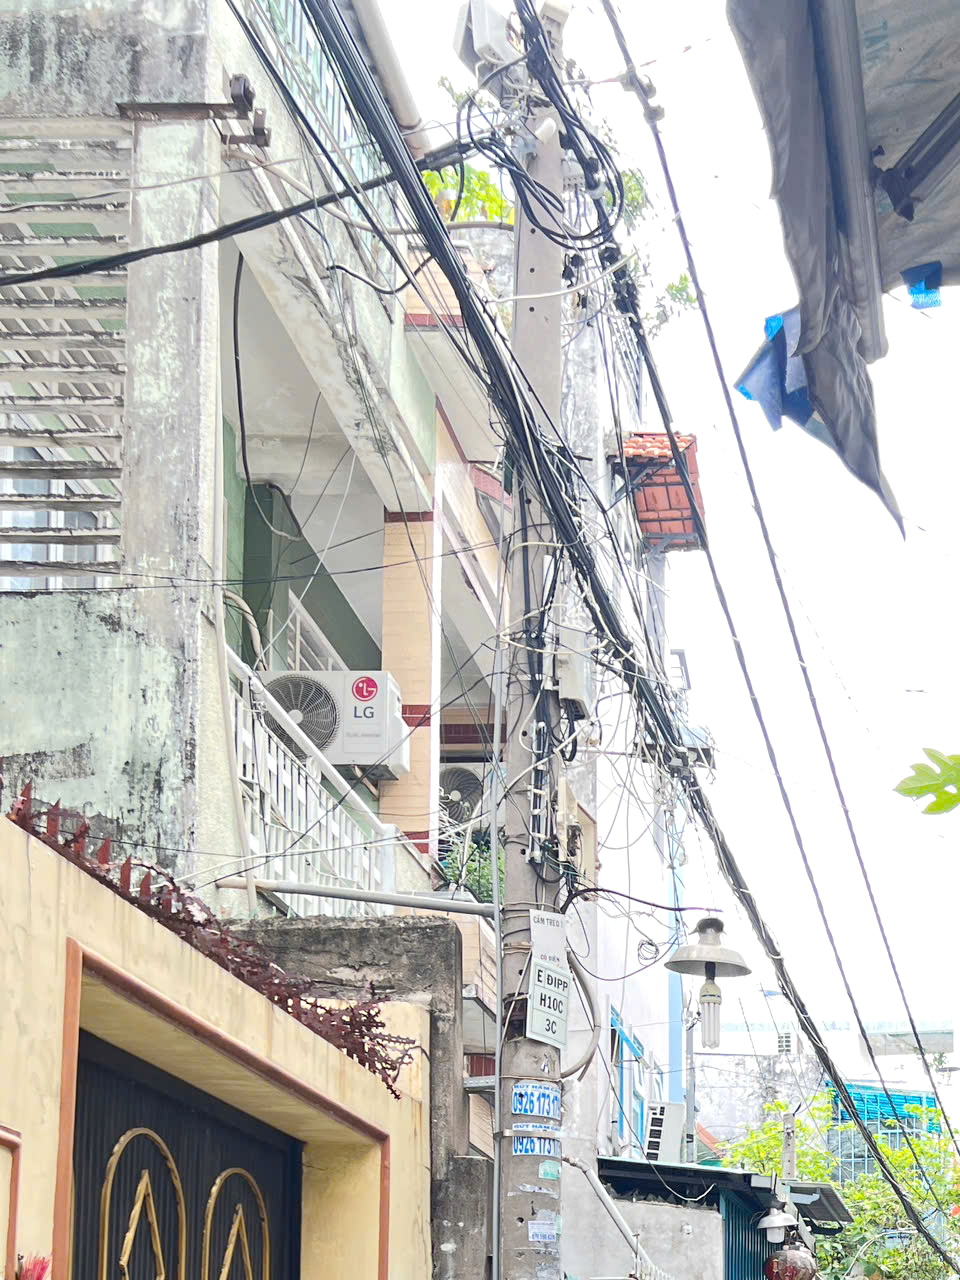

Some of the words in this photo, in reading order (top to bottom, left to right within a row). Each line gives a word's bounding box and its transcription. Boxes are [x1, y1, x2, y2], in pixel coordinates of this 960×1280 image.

[353, 706, 375, 718] LG
[537, 970, 543, 982] E
[540, 992, 563, 1014] H10C
[545, 1019, 557, 1034] 3C
